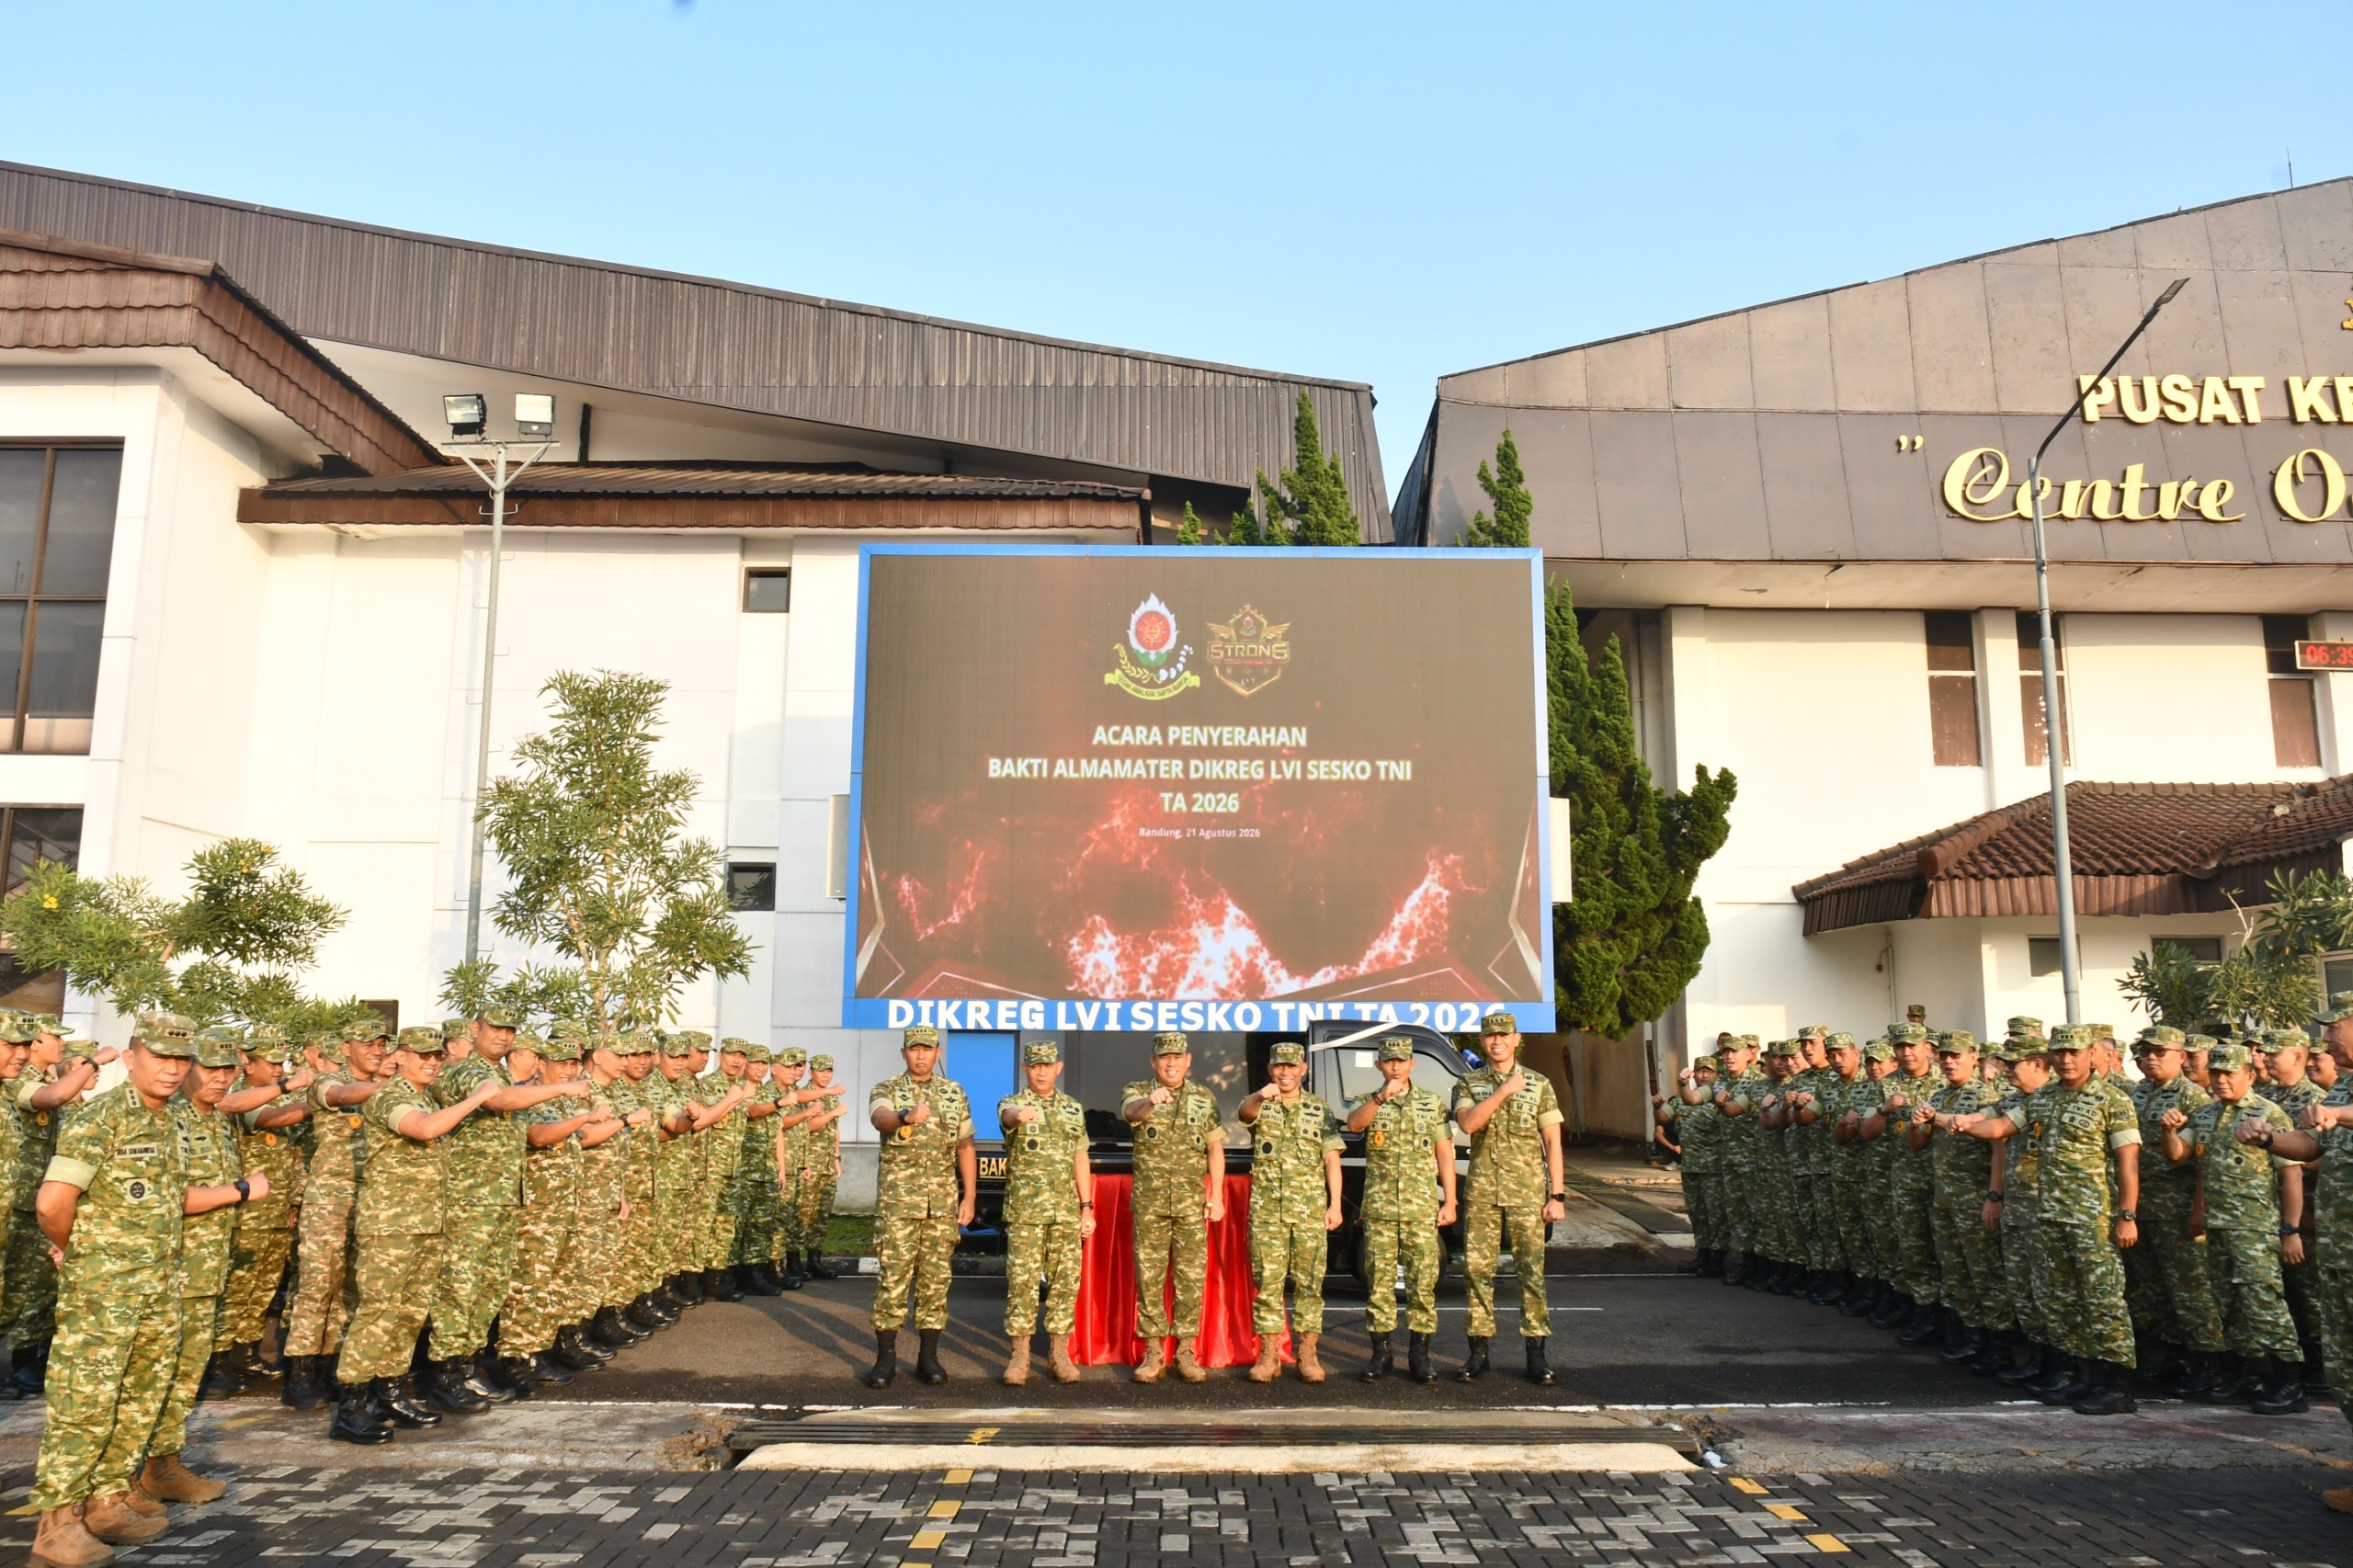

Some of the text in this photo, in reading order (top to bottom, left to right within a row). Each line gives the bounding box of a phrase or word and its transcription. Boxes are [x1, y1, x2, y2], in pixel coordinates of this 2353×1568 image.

[2079, 374, 2266, 424] PUSAT
[1944, 448, 2246, 520] Centre
[2274, 448, 2353, 522] O
[1092, 725, 1307, 747] ACARA PENYERAHAN
[988, 758, 1412, 780] BAKTI ALMAMATER DIKREG LVI SESKO TNI
[1161, 792, 1240, 812] TA 2026
[1139, 827, 1260, 839] Bandung, 21 Agustus 2026
[887, 999, 1046, 1031] DIKREG
[1057, 1002, 1121, 1031] LVI
[1130, 1002, 1262, 1031] SESKO
[2072, 1105, 2097, 1117] TNI AD
